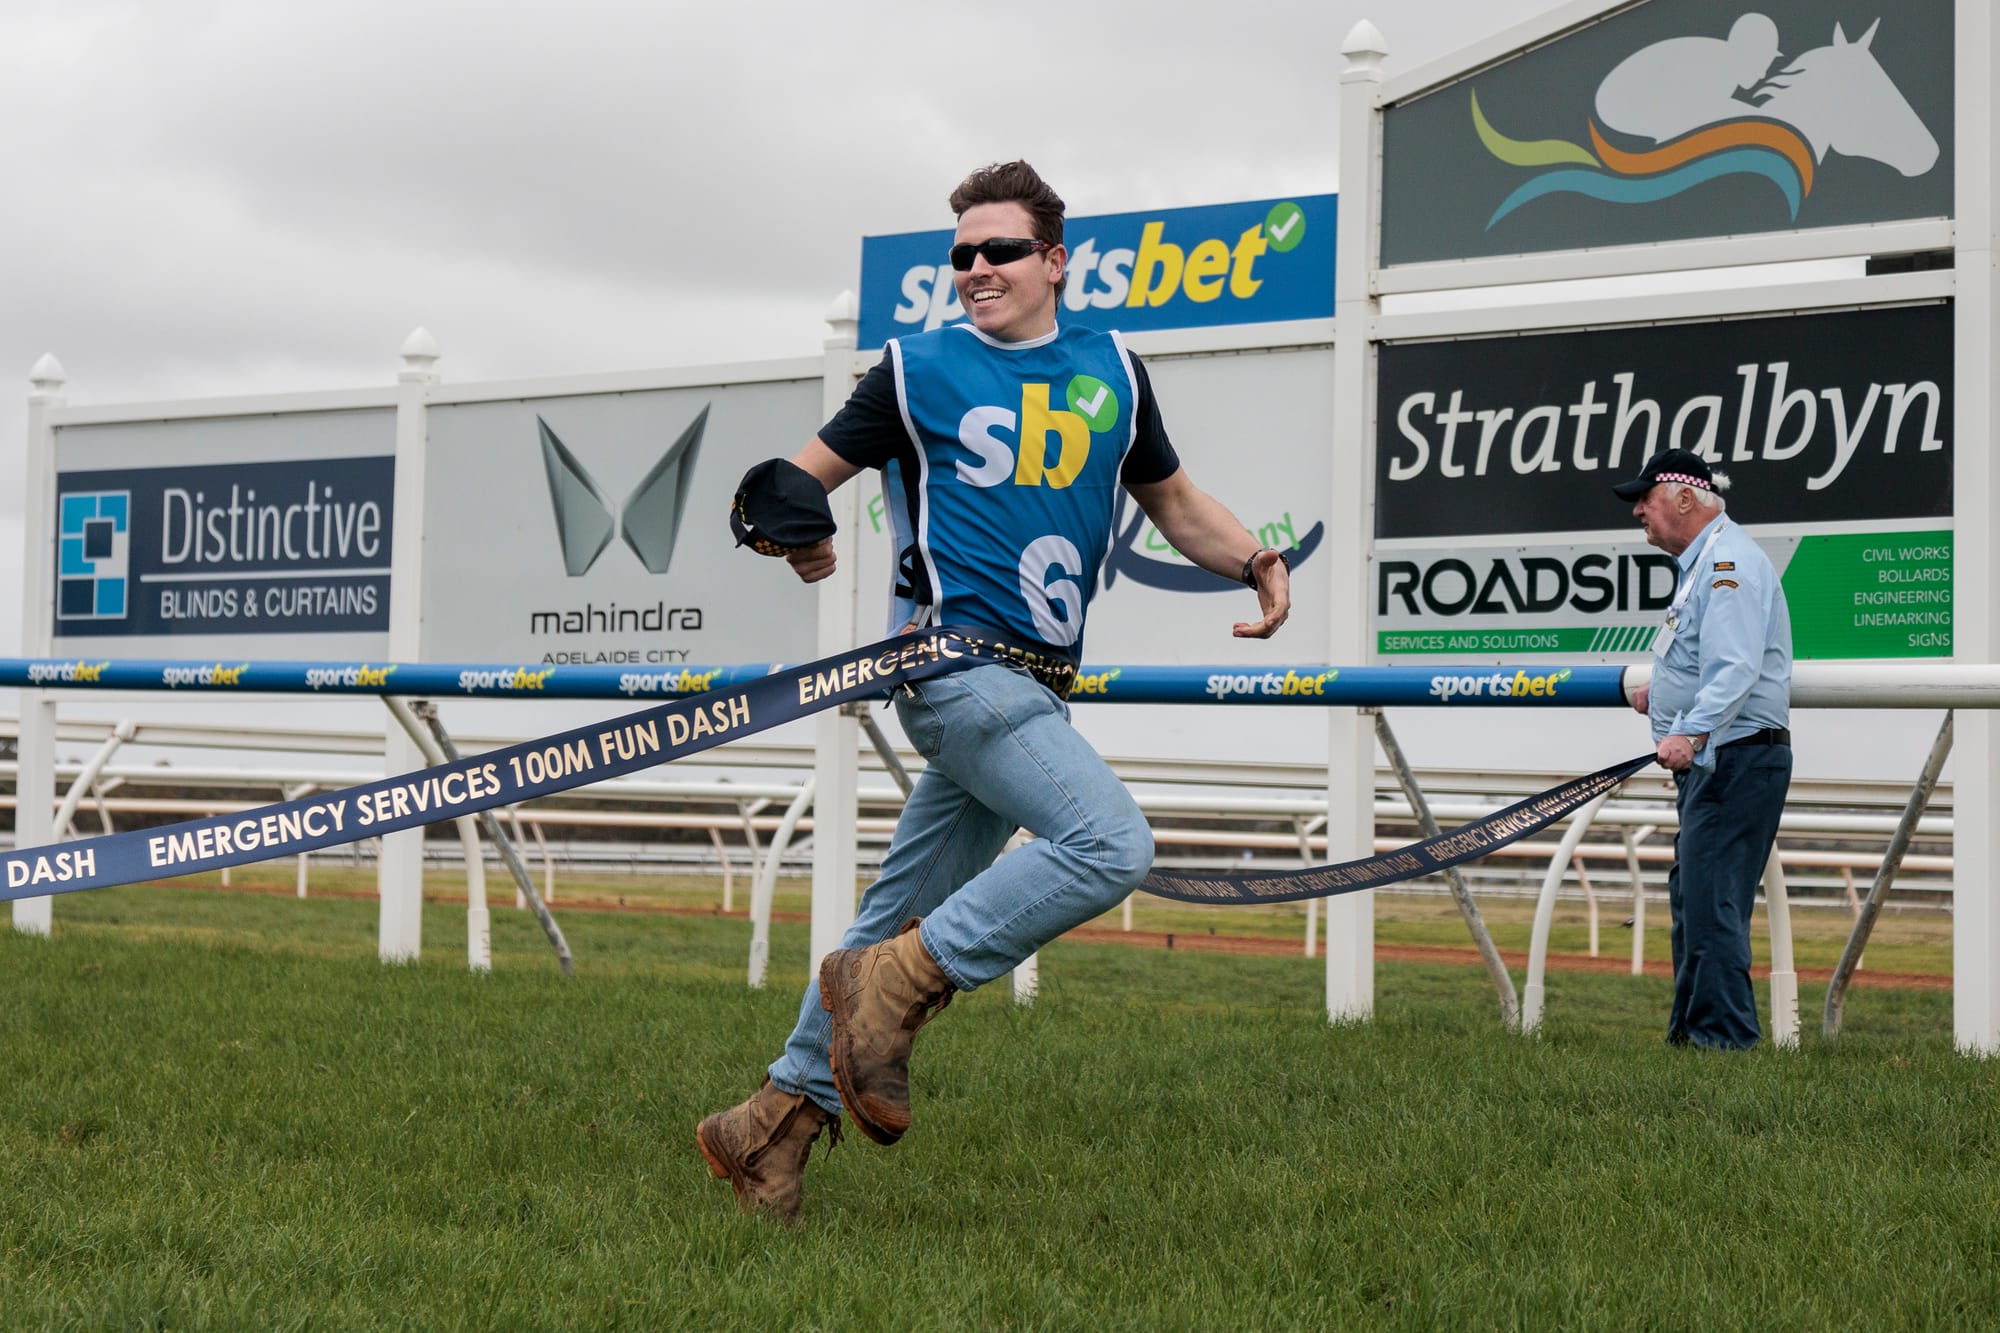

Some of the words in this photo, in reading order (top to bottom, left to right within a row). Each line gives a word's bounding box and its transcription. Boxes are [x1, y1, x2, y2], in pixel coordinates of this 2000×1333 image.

[894, 222, 1269, 332] sptsbet
[956, 383, 1091, 489] sb
[1388, 361, 1944, 491] Strathalbyn
[161, 481, 382, 564] Distinctive
[1862, 549, 1896, 562] CIVIL
[1898, 546, 1951, 561] WORKS
[1378, 554, 1679, 616] ROADSID
[1878, 568, 1950, 583] BOLLARDS
[161, 587, 238, 619] BLINDS
[243, 591, 259, 617] &
[264, 585, 378, 618] CURTAINS
[1018, 535, 1083, 647] 6
[1853, 589, 1951, 606] ENGINEERING
[531, 602, 703, 634] mahindra
[1853, 611, 1951, 627] LINEMARKING
[1384, 635, 1445, 650] SERVICES
[1447, 635, 1479, 649] AND
[1483, 634, 1559, 649] SOLUTIONS
[1907, 632, 1951, 647] SIGNS
[541, 650, 641, 664] ADELAIDE
[647, 649, 691, 663] CITY
[798, 633, 984, 705] EMERGENCY
[27, 661, 102, 685] sportsbet
[162, 664, 241, 689] sportsbet
[305, 662, 389, 690] sportsbet
[458, 667, 546, 693] sportsbet
[619, 668, 712, 697] sportsbet
[1206, 670, 1326, 699] sportsbet
[1429, 670, 1559, 701] sportsbet
[148, 800, 346, 867] EMERGENCY
[357, 763, 501, 826] SERVICES
[509, 739, 594, 788] 100M
[598, 719, 660, 766] FUN
[667, 694, 751, 747] DASH
[1424, 827, 1493, 862] EMERGENCY
[1486, 807, 1541, 841] SERVICES
[7, 848, 96, 888] DASH
